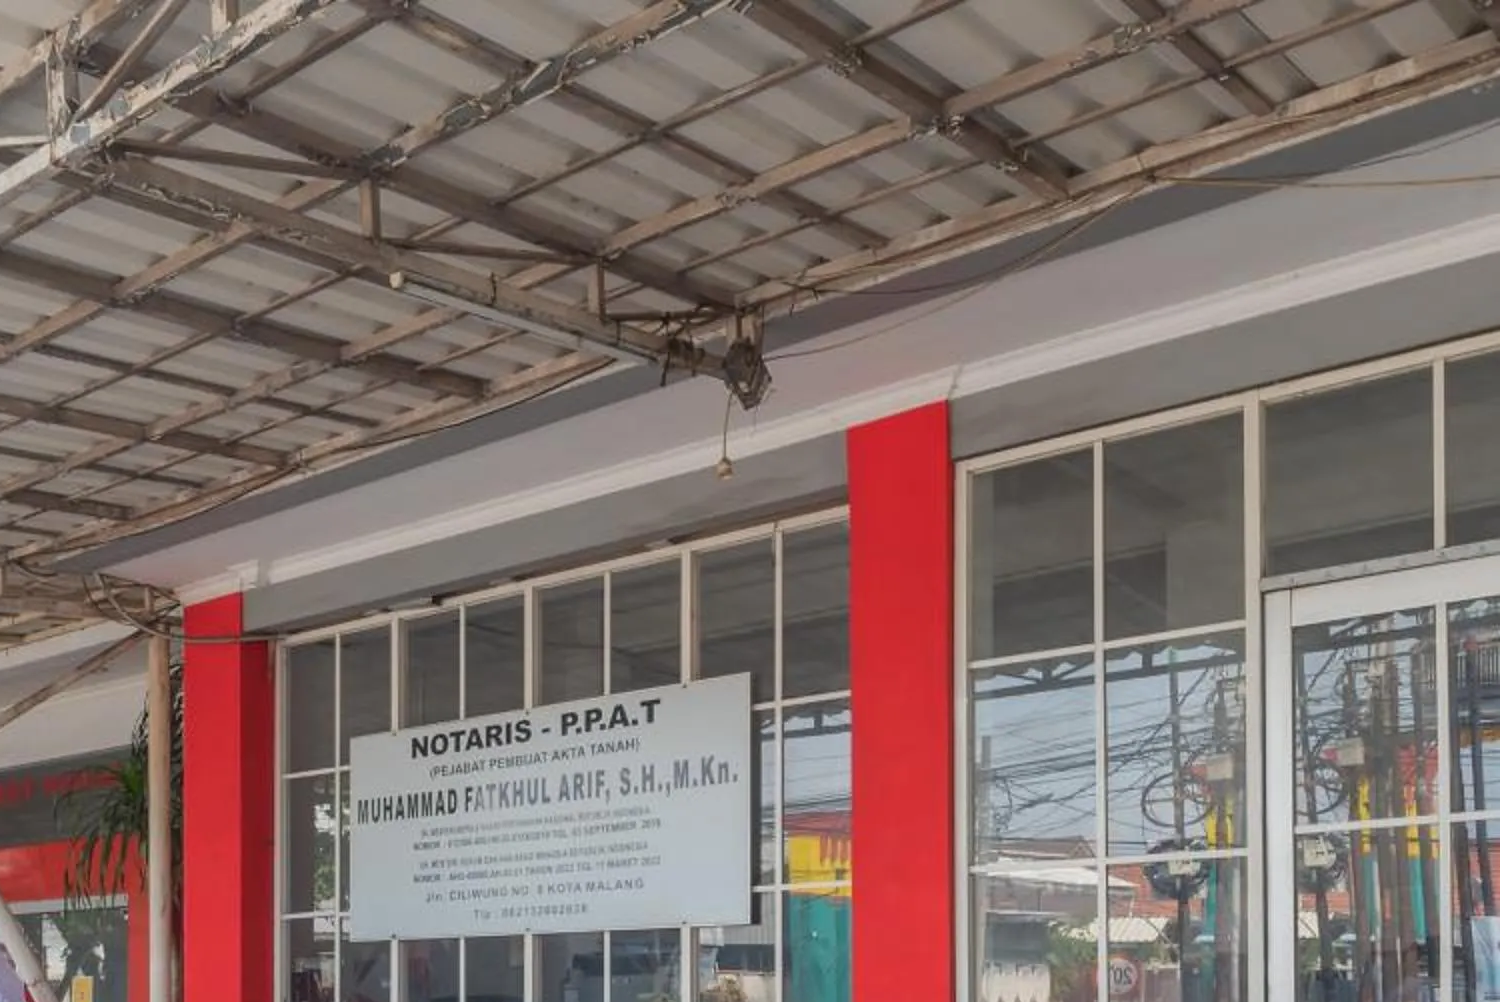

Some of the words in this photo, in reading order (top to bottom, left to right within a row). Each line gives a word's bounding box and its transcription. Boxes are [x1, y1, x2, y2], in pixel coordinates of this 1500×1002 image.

[411, 719, 532, 759] NOTARIS
[561, 697, 661, 737] P.P.A.T
[489, 751, 547, 770] PEMBUAT
[551, 746, 585, 762] AKTA
[357, 788, 458, 825] MUHAMMAD
[464, 778, 550, 812] FATKHUL
[558, 769, 610, 803] ARIF,
[586, 877, 645, 893] MALANG
